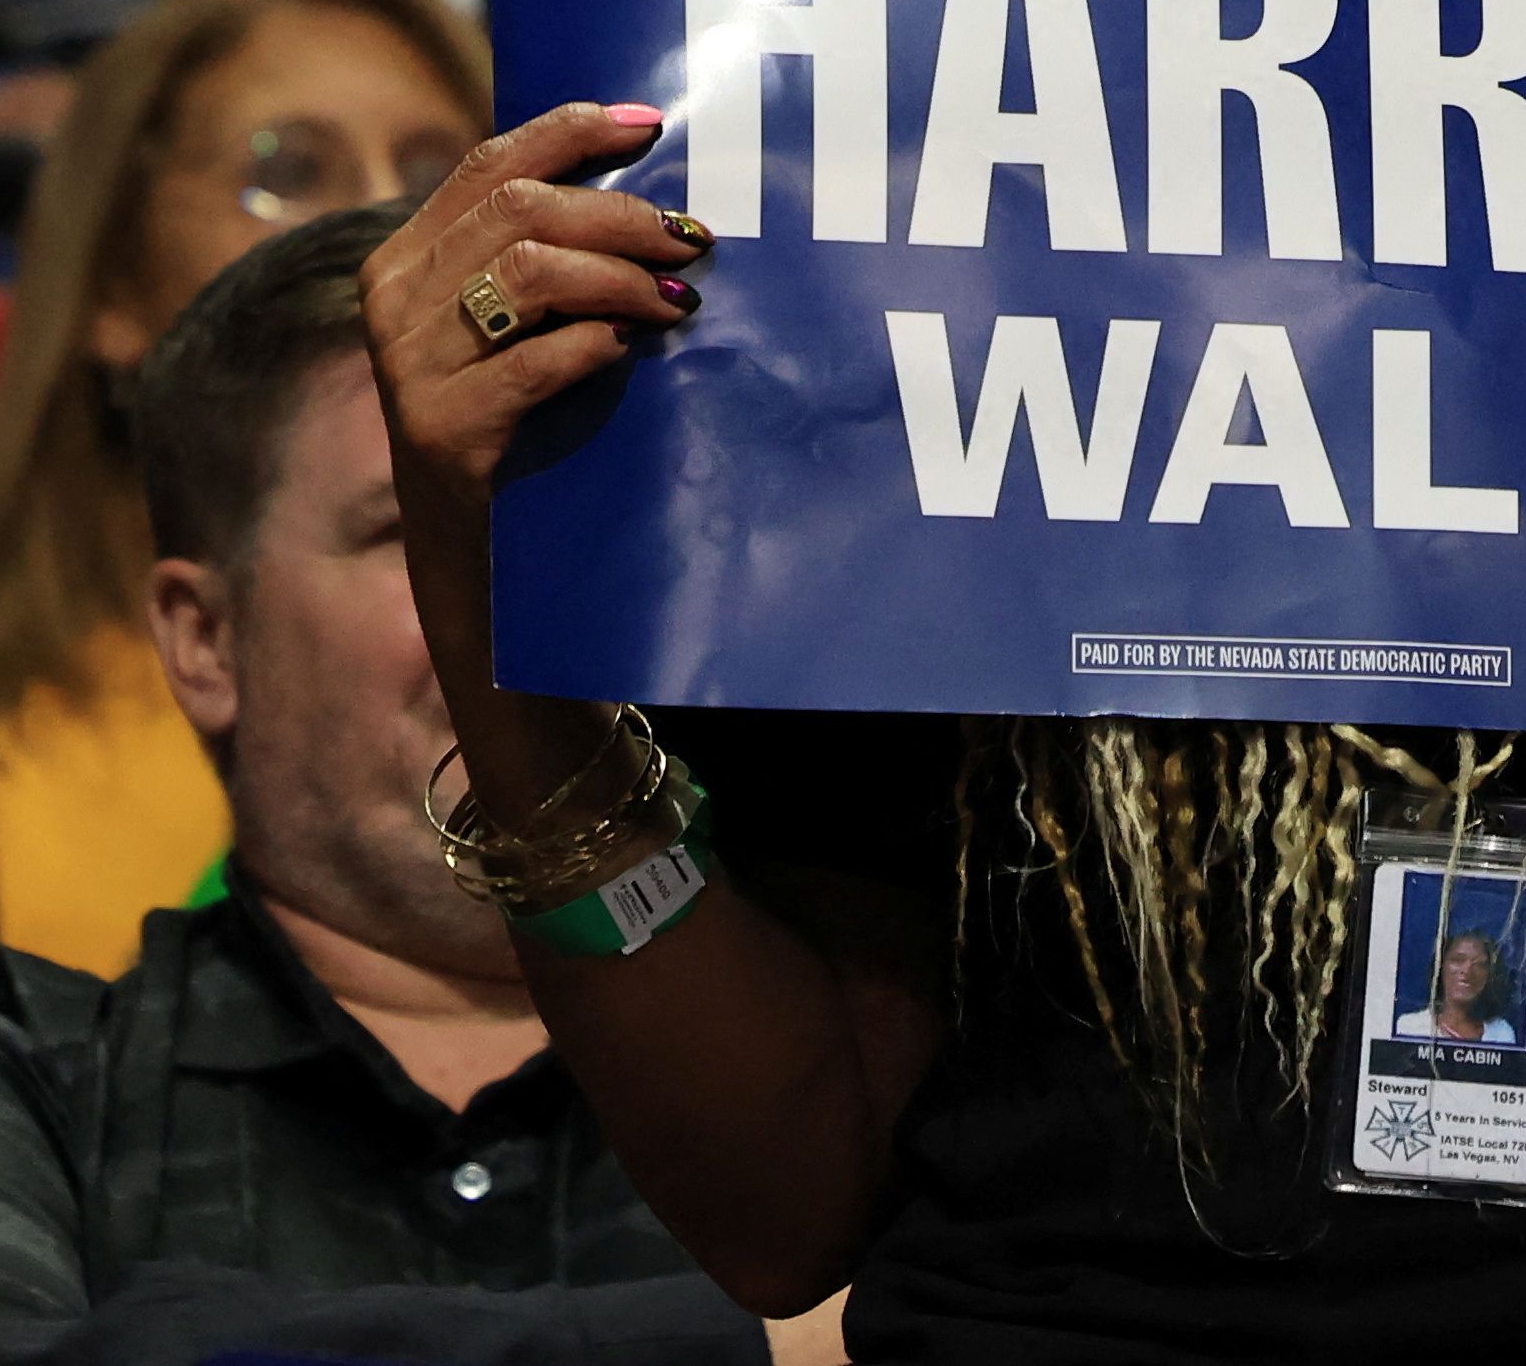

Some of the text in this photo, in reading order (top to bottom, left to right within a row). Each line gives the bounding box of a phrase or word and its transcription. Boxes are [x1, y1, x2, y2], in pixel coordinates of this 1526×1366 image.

[1080, 642, 1502, 678] PAID FOR BY THE NEVADA STATE DEMOCRATIC PARTY
[1454, 1049, 1501, 1066] CABIN
[1368, 1080, 1428, 1097] Steward
[1445, 1112, 1476, 1124] Years
[1441, 1135, 1474, 1147] IATSE
[1478, 1138, 1508, 1150] Local
[1440, 1149, 1459, 1160] Las
[1503, 1154, 1520, 1165] NV
